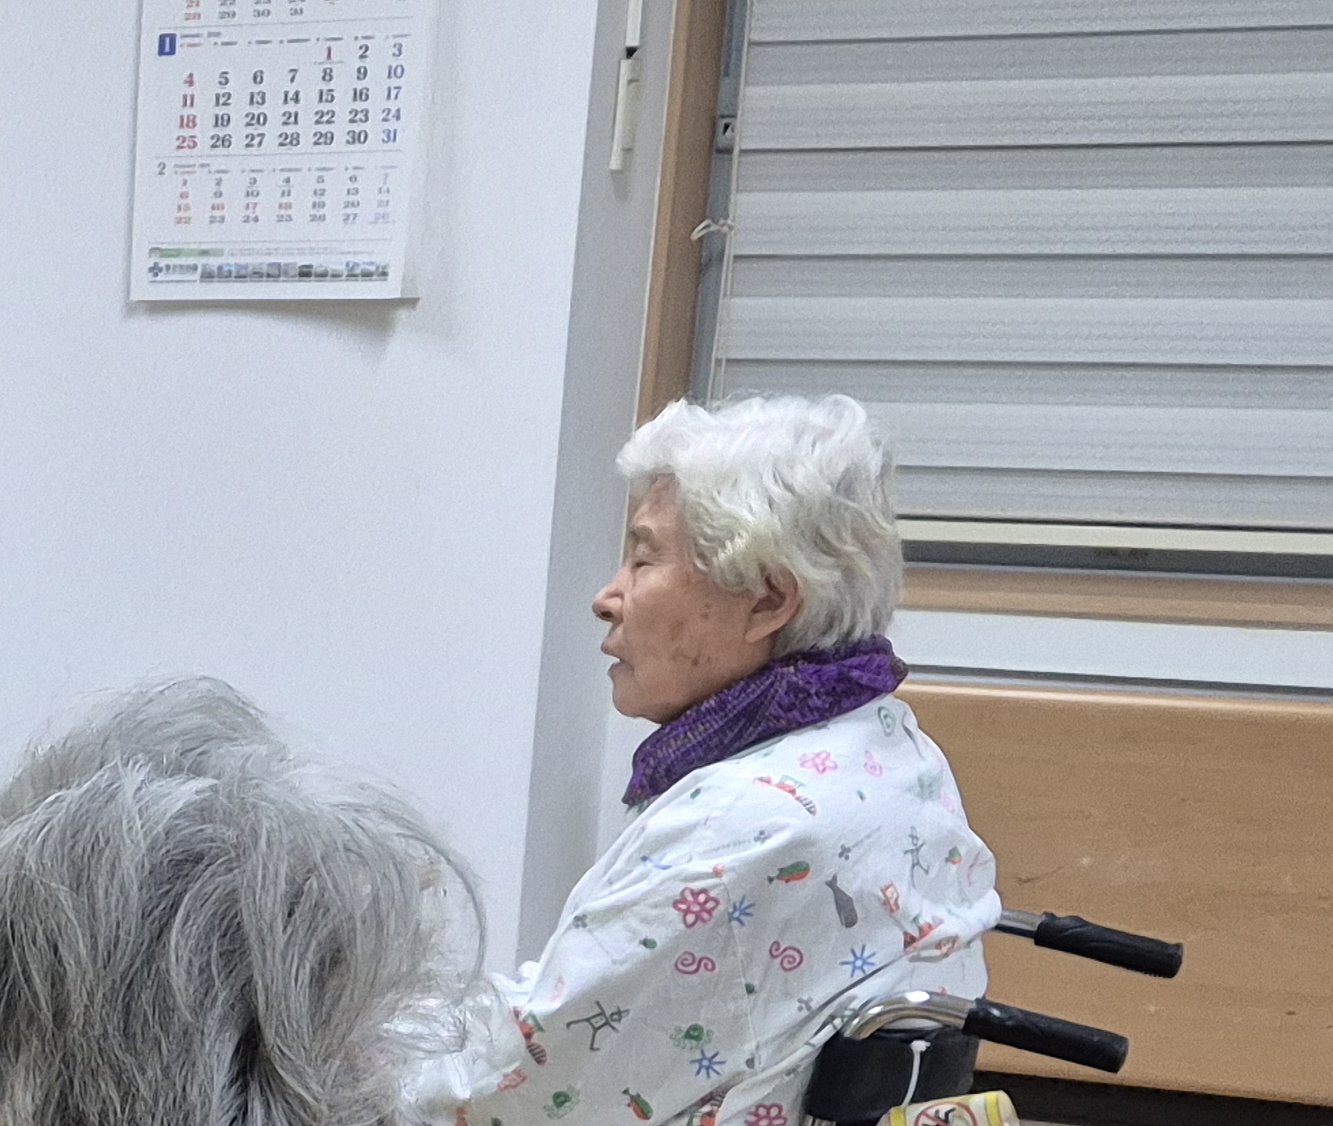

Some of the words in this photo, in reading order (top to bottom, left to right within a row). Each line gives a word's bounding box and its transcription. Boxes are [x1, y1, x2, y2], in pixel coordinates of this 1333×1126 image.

[359, 44, 369, 60] 2
[392, 43, 403, 57] 3
[184, 73, 194, 87] 4
[218, 71, 229, 86] 5
[253, 70, 264, 84] 6
[289, 69, 298, 84] 7
[322, 67, 333, 82] 8
[357, 66, 368, 81] 9
[387, 65, 404, 79] 10
[182, 94, 195, 108] 11
[215, 92, 231, 107] 12
[249, 91, 266, 106] 13
[283, 90, 300, 104] 14
[318, 89, 335, 103] 15
[353, 88, 369, 102] 16
[386, 86, 402, 100] 17
[179, 114, 197, 129] 18
[213, 113, 230, 128] 19
[245, 112, 267, 127] 20
[282, 111, 298, 126] 21
[314, 110, 335, 125] 22
[349, 108, 369, 123] 23
[381, 108, 400, 122] 24
[176, 135, 197, 150] 25
[210, 134, 232, 148] 26
[245, 133, 265, 148] 27
[278, 132, 300, 146] 28
[313, 131, 334, 145] 29
[346, 130, 368, 145] 30
[382, 129, 397, 144] 31
[158, 162, 166, 175] 2
